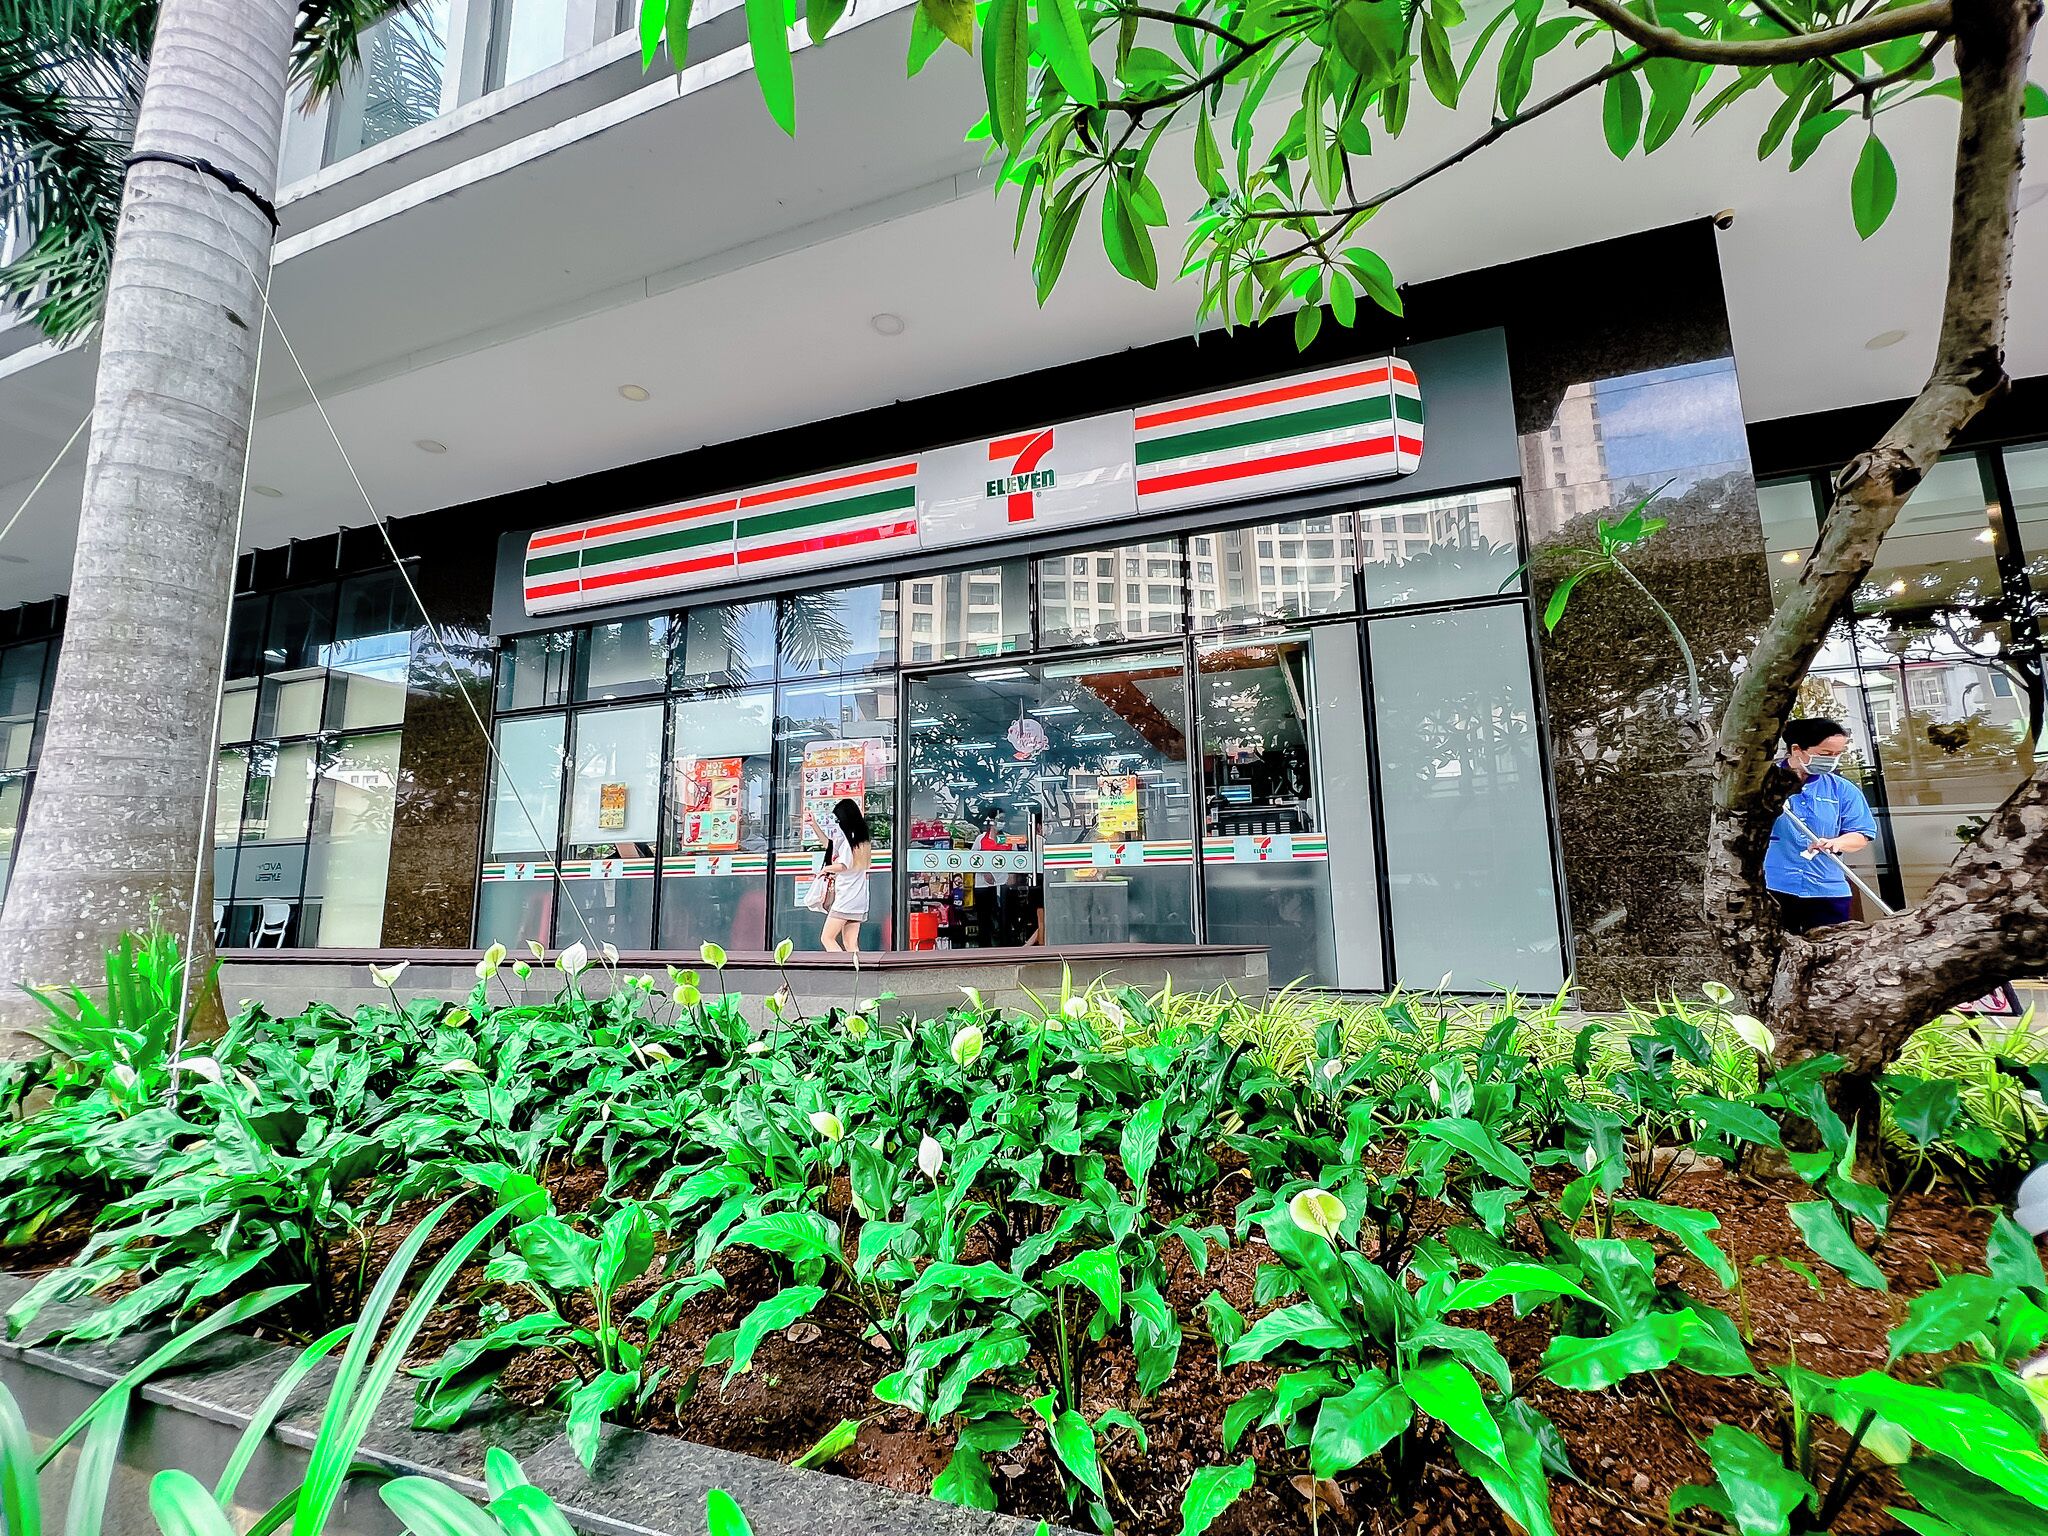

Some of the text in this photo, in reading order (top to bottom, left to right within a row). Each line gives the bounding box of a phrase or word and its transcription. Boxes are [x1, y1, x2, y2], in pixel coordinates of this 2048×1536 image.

[989, 428, 1054, 523] 7
[701, 768, 728, 778] DEALS
[706, 761, 724, 770] HOT
[1110, 844, 1125, 864] 7
[1254, 836, 1271, 860] 7
